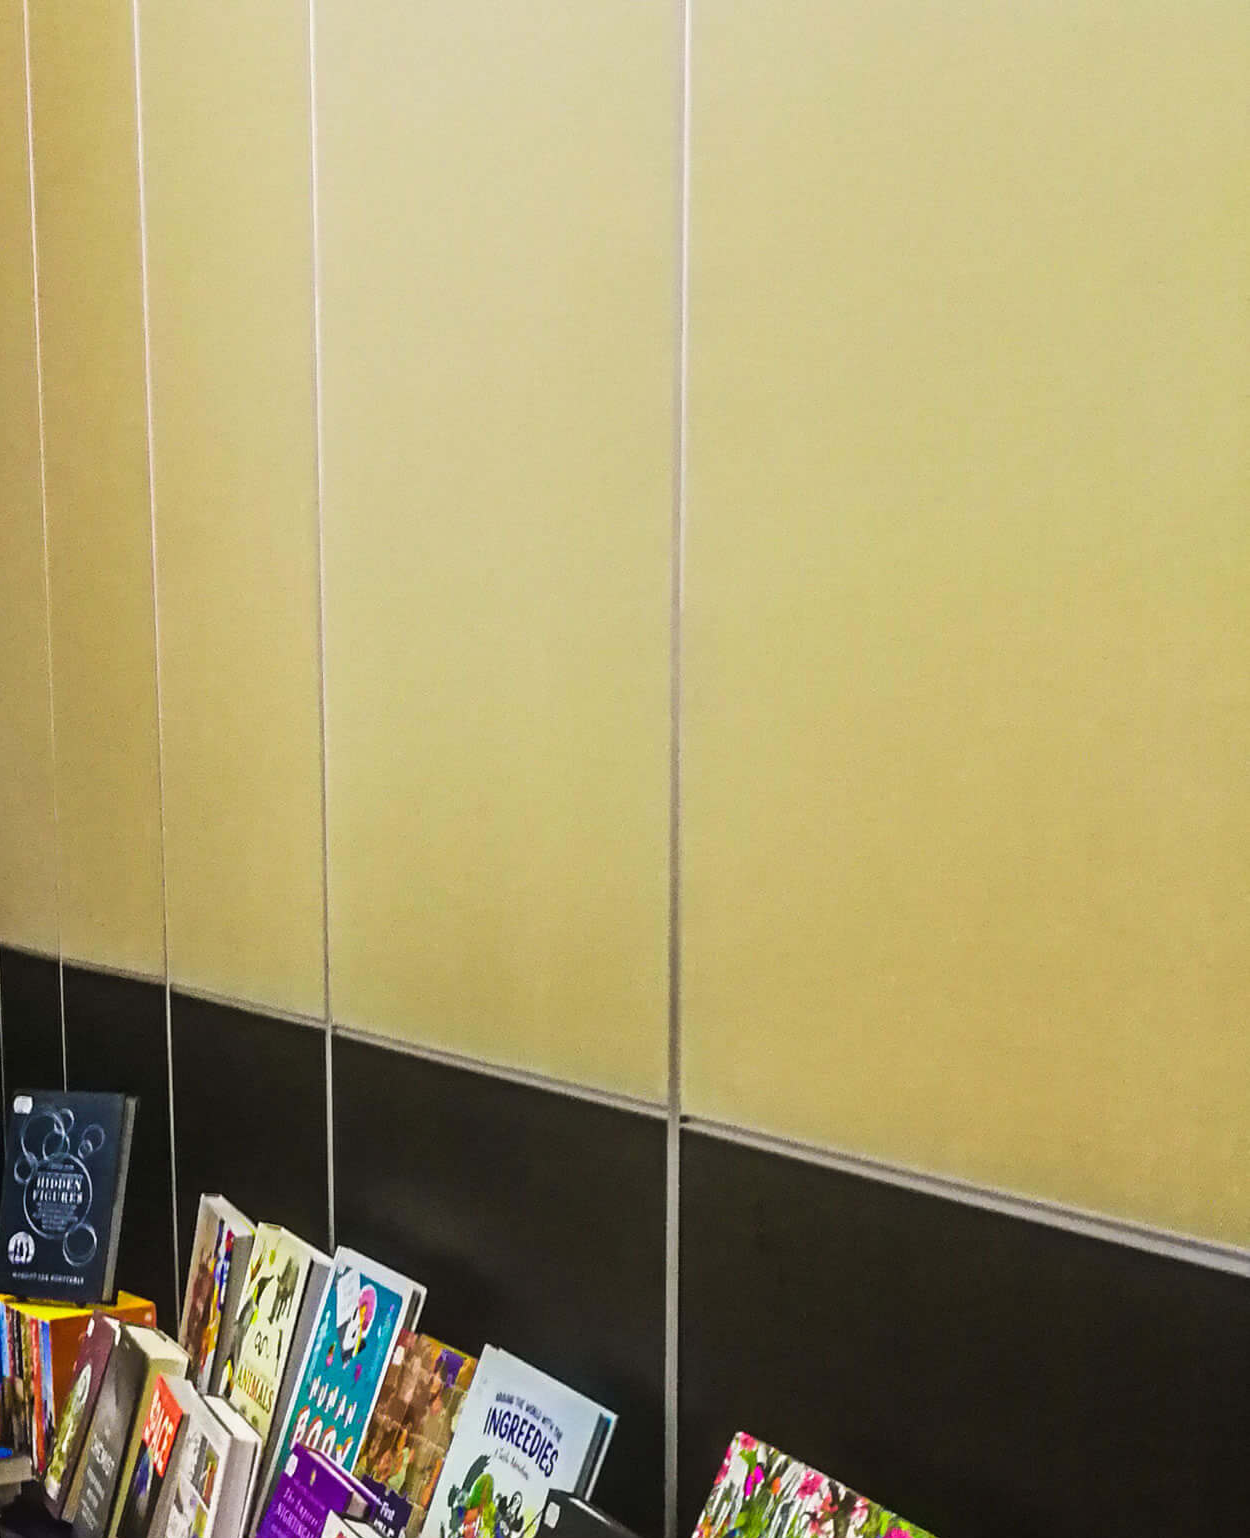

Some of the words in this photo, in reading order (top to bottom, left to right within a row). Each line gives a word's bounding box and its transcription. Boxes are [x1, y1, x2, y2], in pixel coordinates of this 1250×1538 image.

[32, 1189, 83, 1205] FIGURES
[36, 1175, 82, 1191] HIDDEN
[237, 1364, 274, 1415] ANIMALS
[308, 1374, 358, 1429] HUMAN
[144, 1387, 175, 1473] SPACE
[289, 1404, 354, 1466] BODY
[482, 1405, 560, 1478] INGREEDIES
